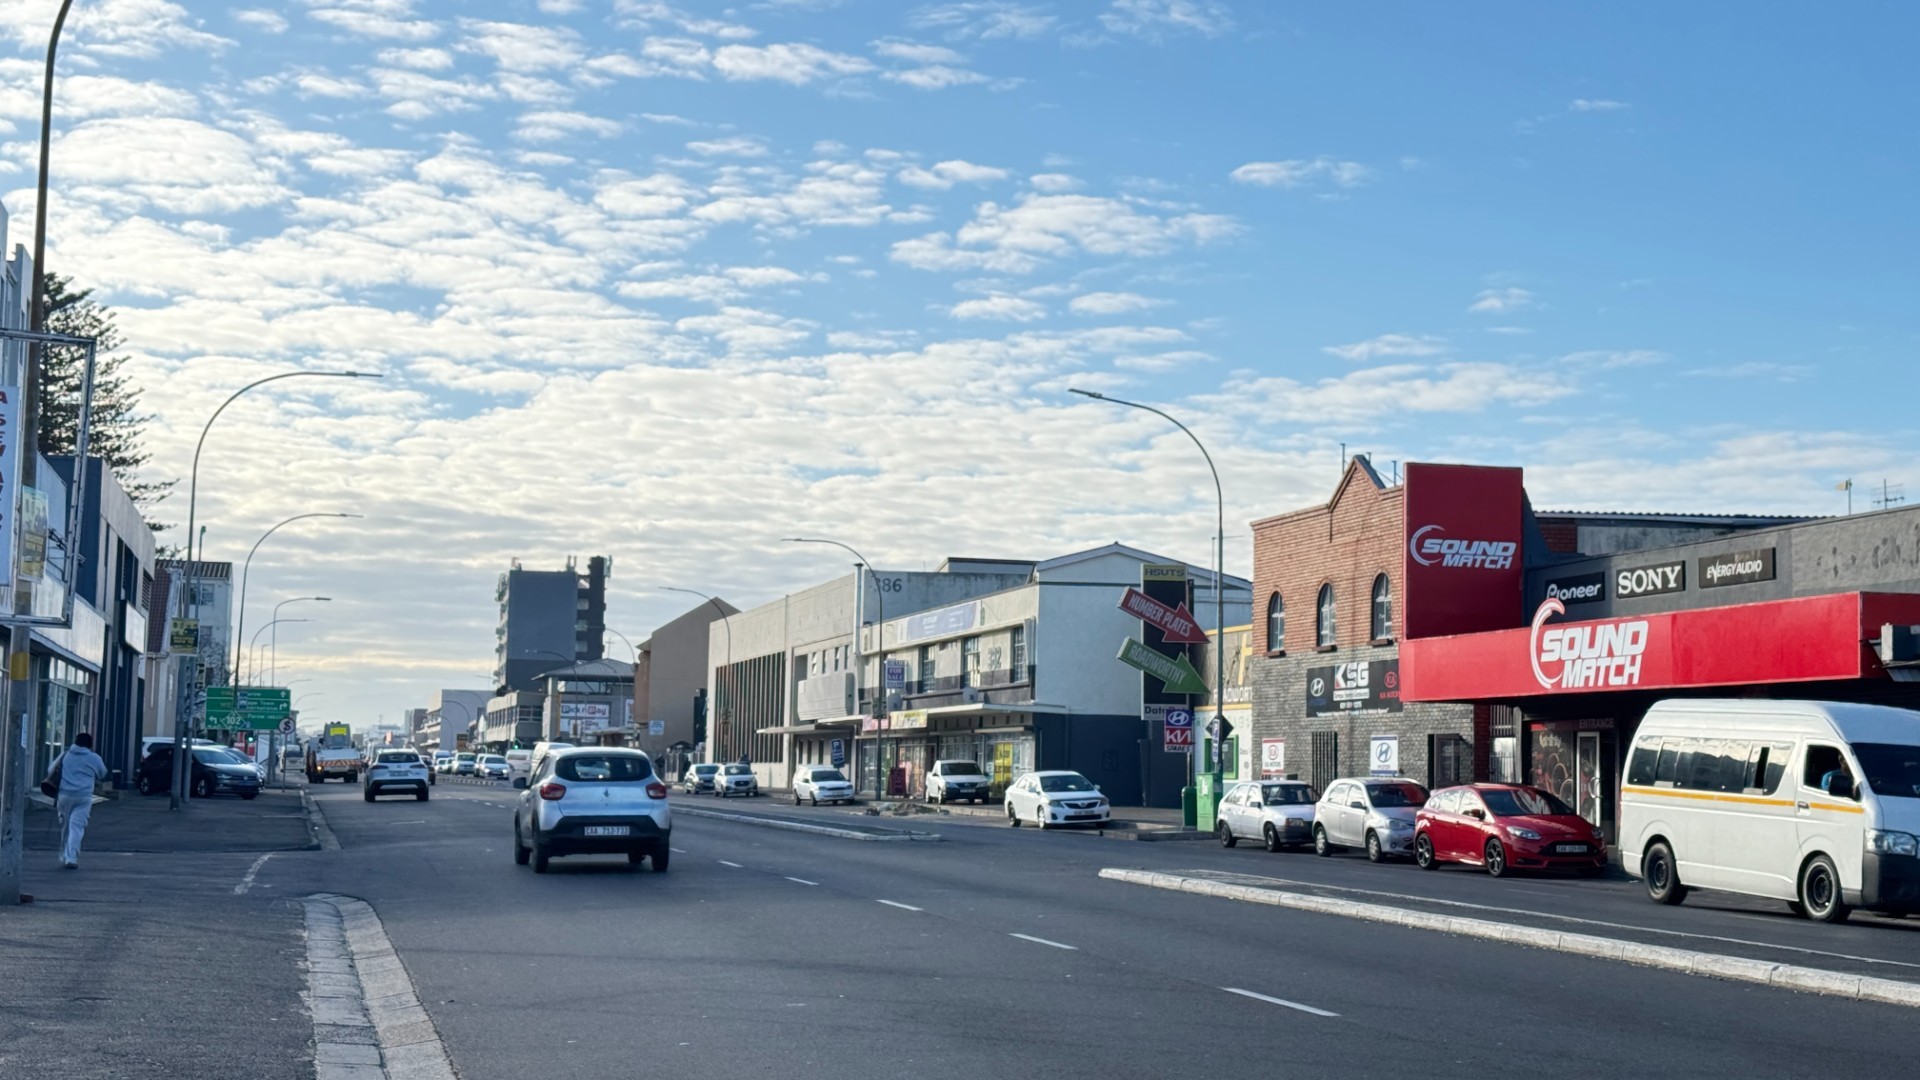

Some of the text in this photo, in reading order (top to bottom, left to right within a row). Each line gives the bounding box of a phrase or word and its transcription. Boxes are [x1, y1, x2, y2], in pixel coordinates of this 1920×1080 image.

[1421, 538, 1517, 556] SOUND
[1442, 554, 1513, 569] MATCH
[1546, 582, 1602, 601] Pioneer
[1617, 565, 1682, 595] SONY
[1128, 593, 1193, 637] NUMBER PLATES
[1540, 620, 1649, 662] SOUND
[1128, 645, 1187, 685] ROADWORTHY
[1561, 655, 1642, 689] MATCH
[227, 716, 241, 724] 102
[1580, 718, 1614, 728] ENTRANCE
